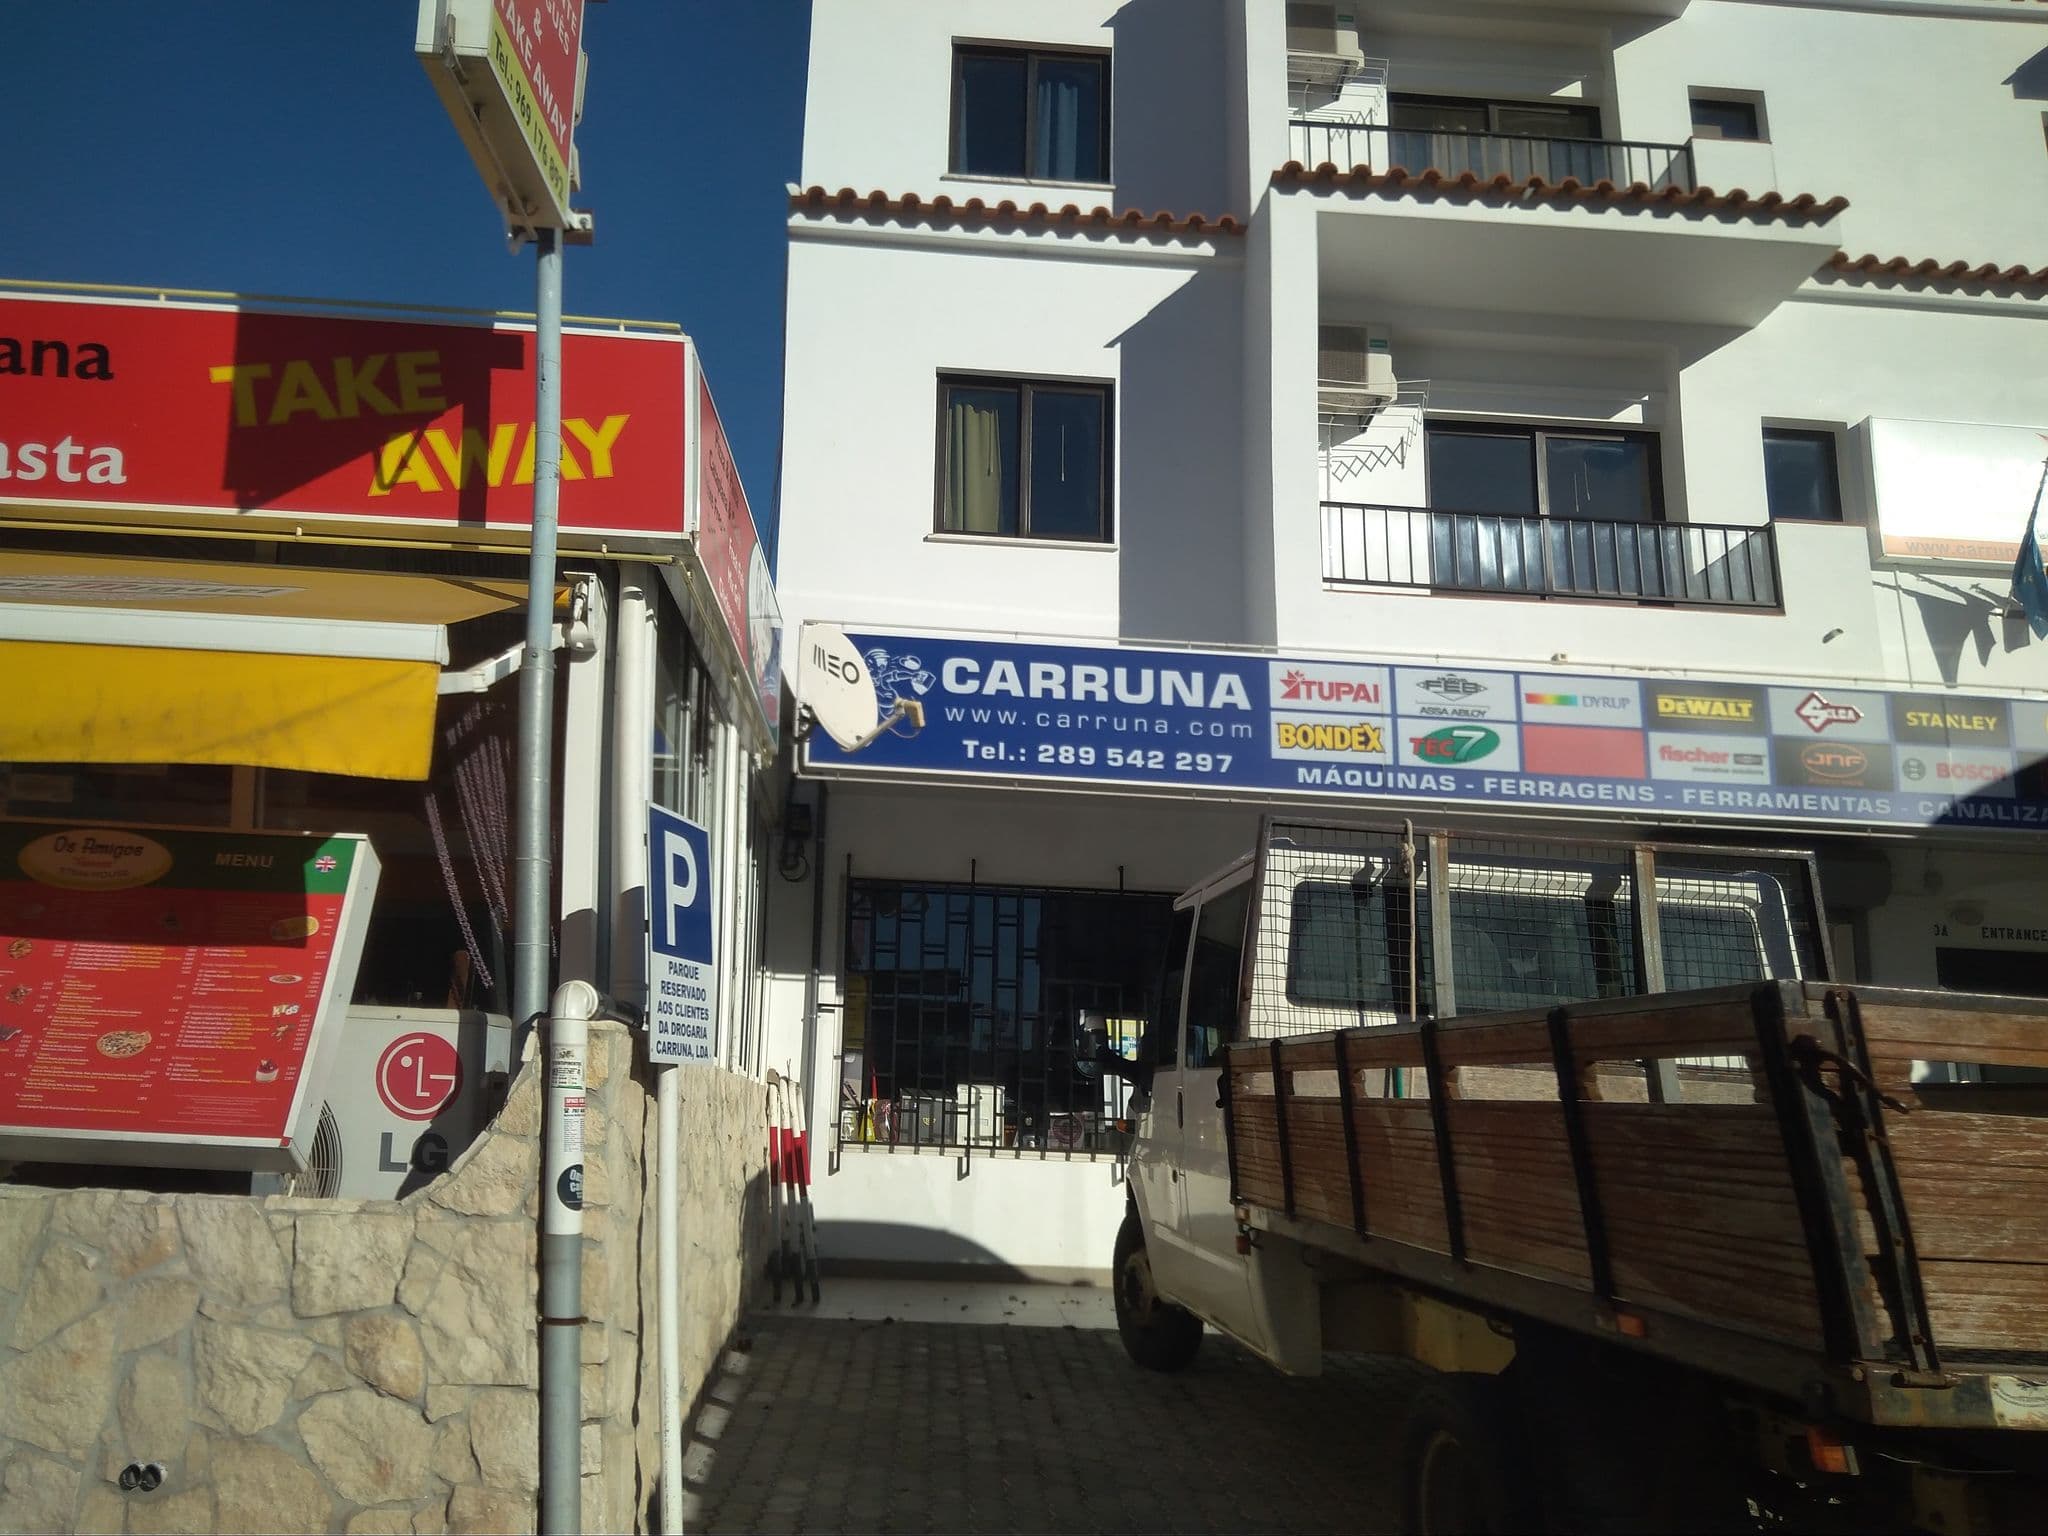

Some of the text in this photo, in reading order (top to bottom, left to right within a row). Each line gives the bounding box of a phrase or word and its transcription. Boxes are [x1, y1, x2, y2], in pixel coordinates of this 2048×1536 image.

[495, 30, 513, 91] Tel.:
[515, 80, 531, 127] 969
[533, 120, 547, 166] 176
[532, 61, 567, 145] AWAY
[208, 350, 447, 427] TAKE
[367, 413, 631, 497] AWAY
[941, 658, 1253, 711] CARRUNA
[1301, 680, 1380, 704] TUPAI
[1420, 706, 1487, 718] ASSA ABLOY
[1582, 695, 1631, 710] DYRUP
[944, 706, 1253, 739] www.carruna.com
[1905, 711, 1997, 731] STANLEY
[1277, 722, 1385, 754] BONDEX
[962, 740, 1233, 773] Tel.: 289 542 297
[1659, 745, 1729, 765] fischer
[1936, 763, 2007, 782] BOSCH
[1297, 765, 1456, 791] MÁQUINAS
[1484, 777, 1656, 802] FERRAGENS
[1682, 788, 1891, 814] FERRAMENTAS
[54, 835, 145, 859] Os Amigos
[215, 852, 274, 868] MENU
[664, 830, 698, 947] P
[1981, 927, 2048, 941] ENTRANCE
[668, 960, 700, 981] PARQUE
[660, 980, 706, 1003] RESERVADO
[657, 1000, 709, 1021] AOS CLIENTES
[658, 1020, 708, 1040] DA DROGARIA
[656, 1040, 695, 1061] CARRUNA,
[378, 1132, 449, 1173] LG
